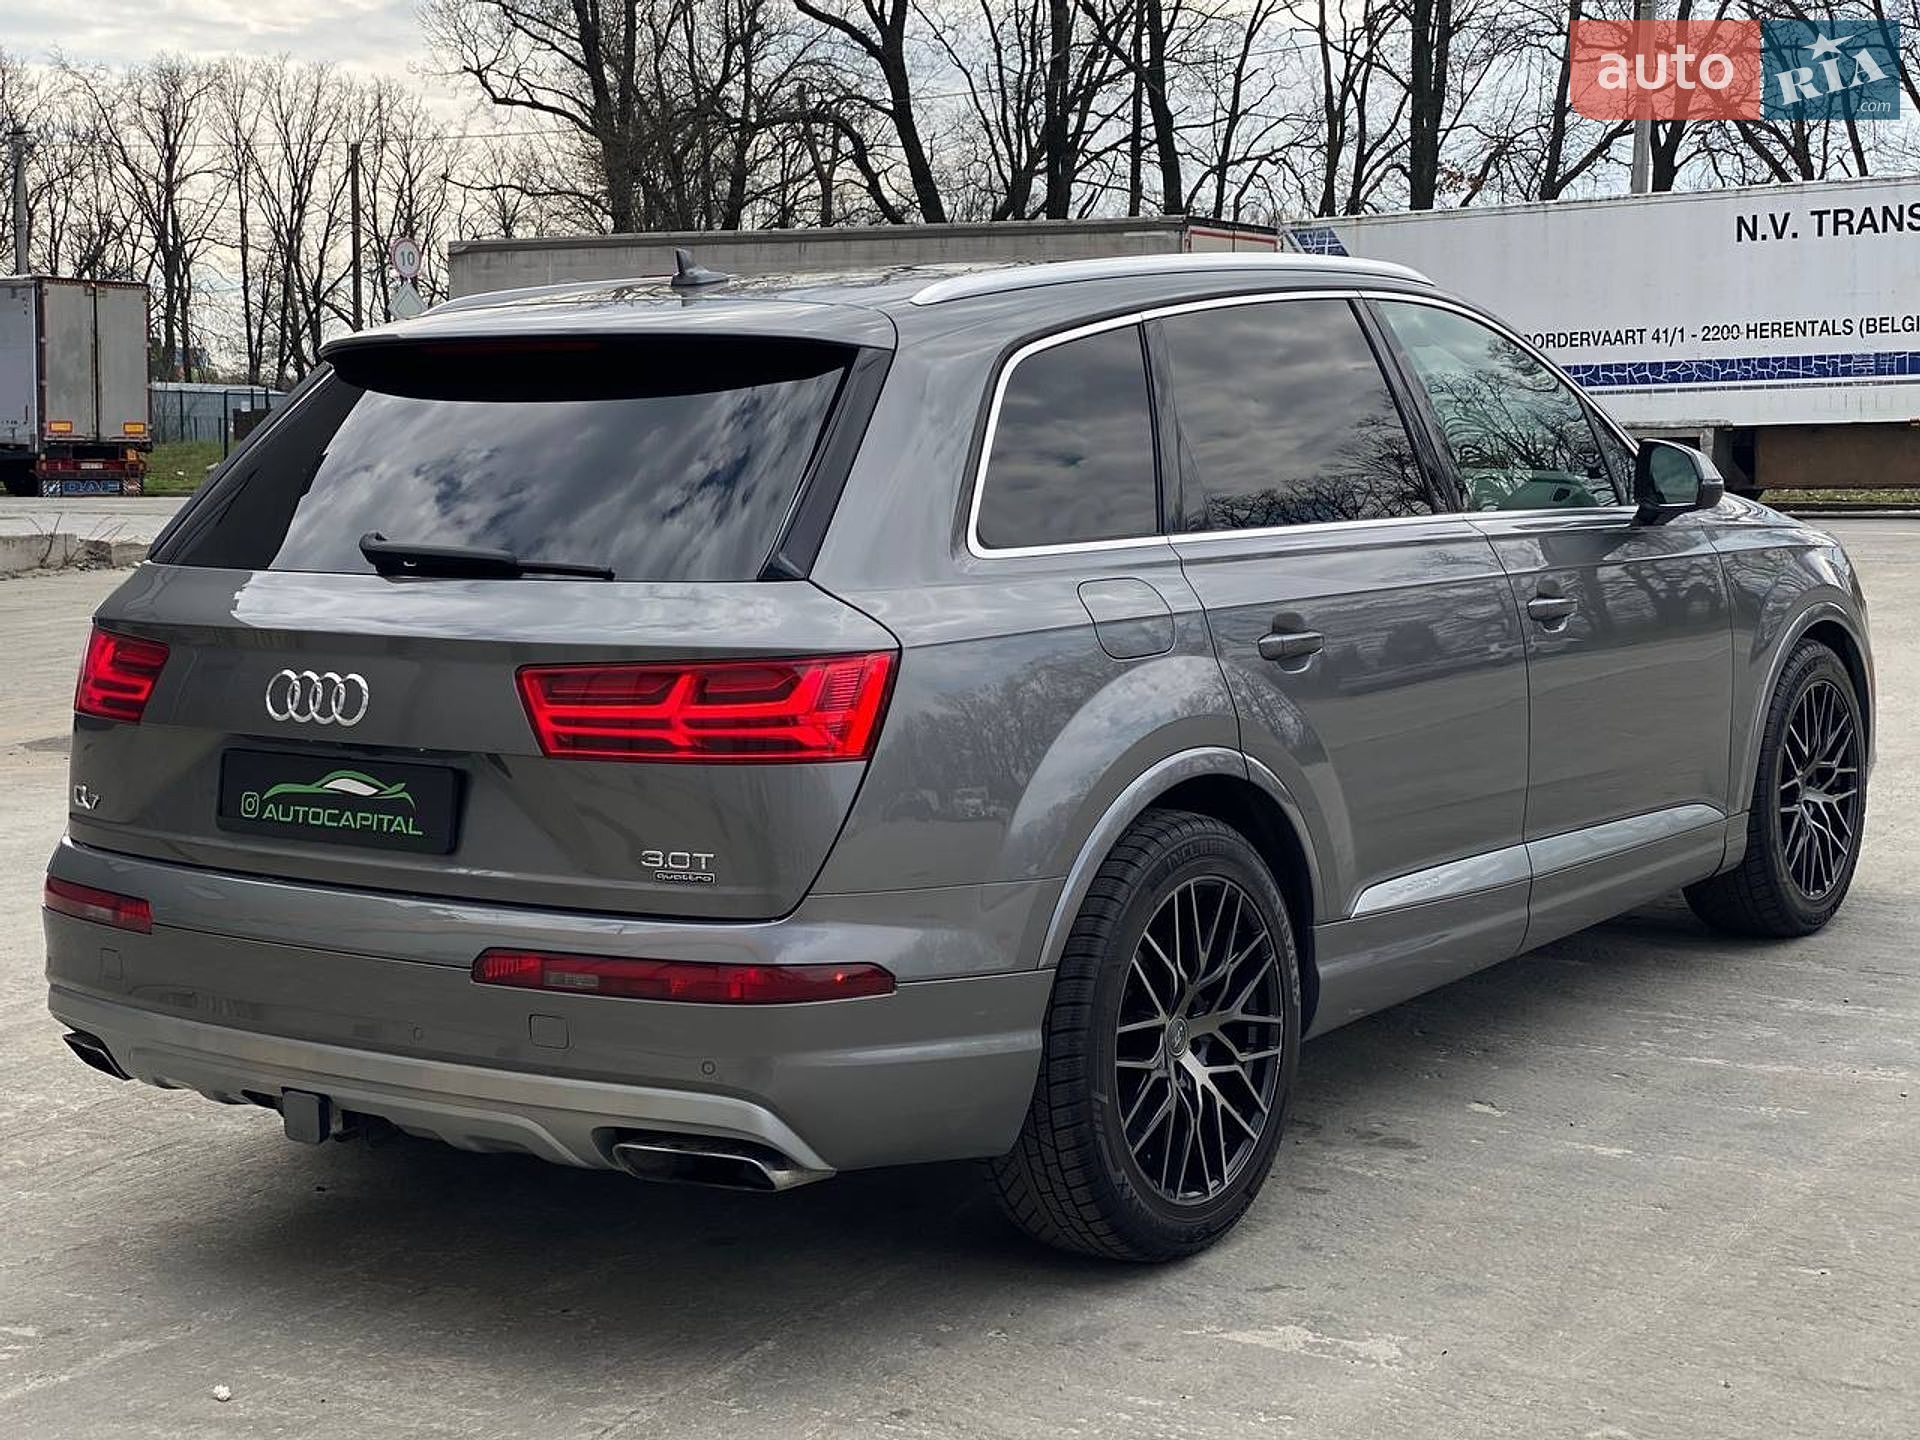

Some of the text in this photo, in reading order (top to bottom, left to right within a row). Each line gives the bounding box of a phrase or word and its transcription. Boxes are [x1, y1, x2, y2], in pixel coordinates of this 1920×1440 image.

[1736, 203, 1920, 242] N.V. TRANS
[400, 251, 415, 267] 10
[1524, 328, 1647, 349] ORDERVAART
[1651, 326, 1685, 347] 41/1
[1701, 324, 1741, 342] 2200
[1746, 318, 1854, 339] HERENTALS
[1859, 314, 1920, 339] (BELGI
[74, 785, 99, 809] Q7
[262, 803, 423, 836] AUTOCAPITAL
[641, 850, 714, 869] 3.0T
